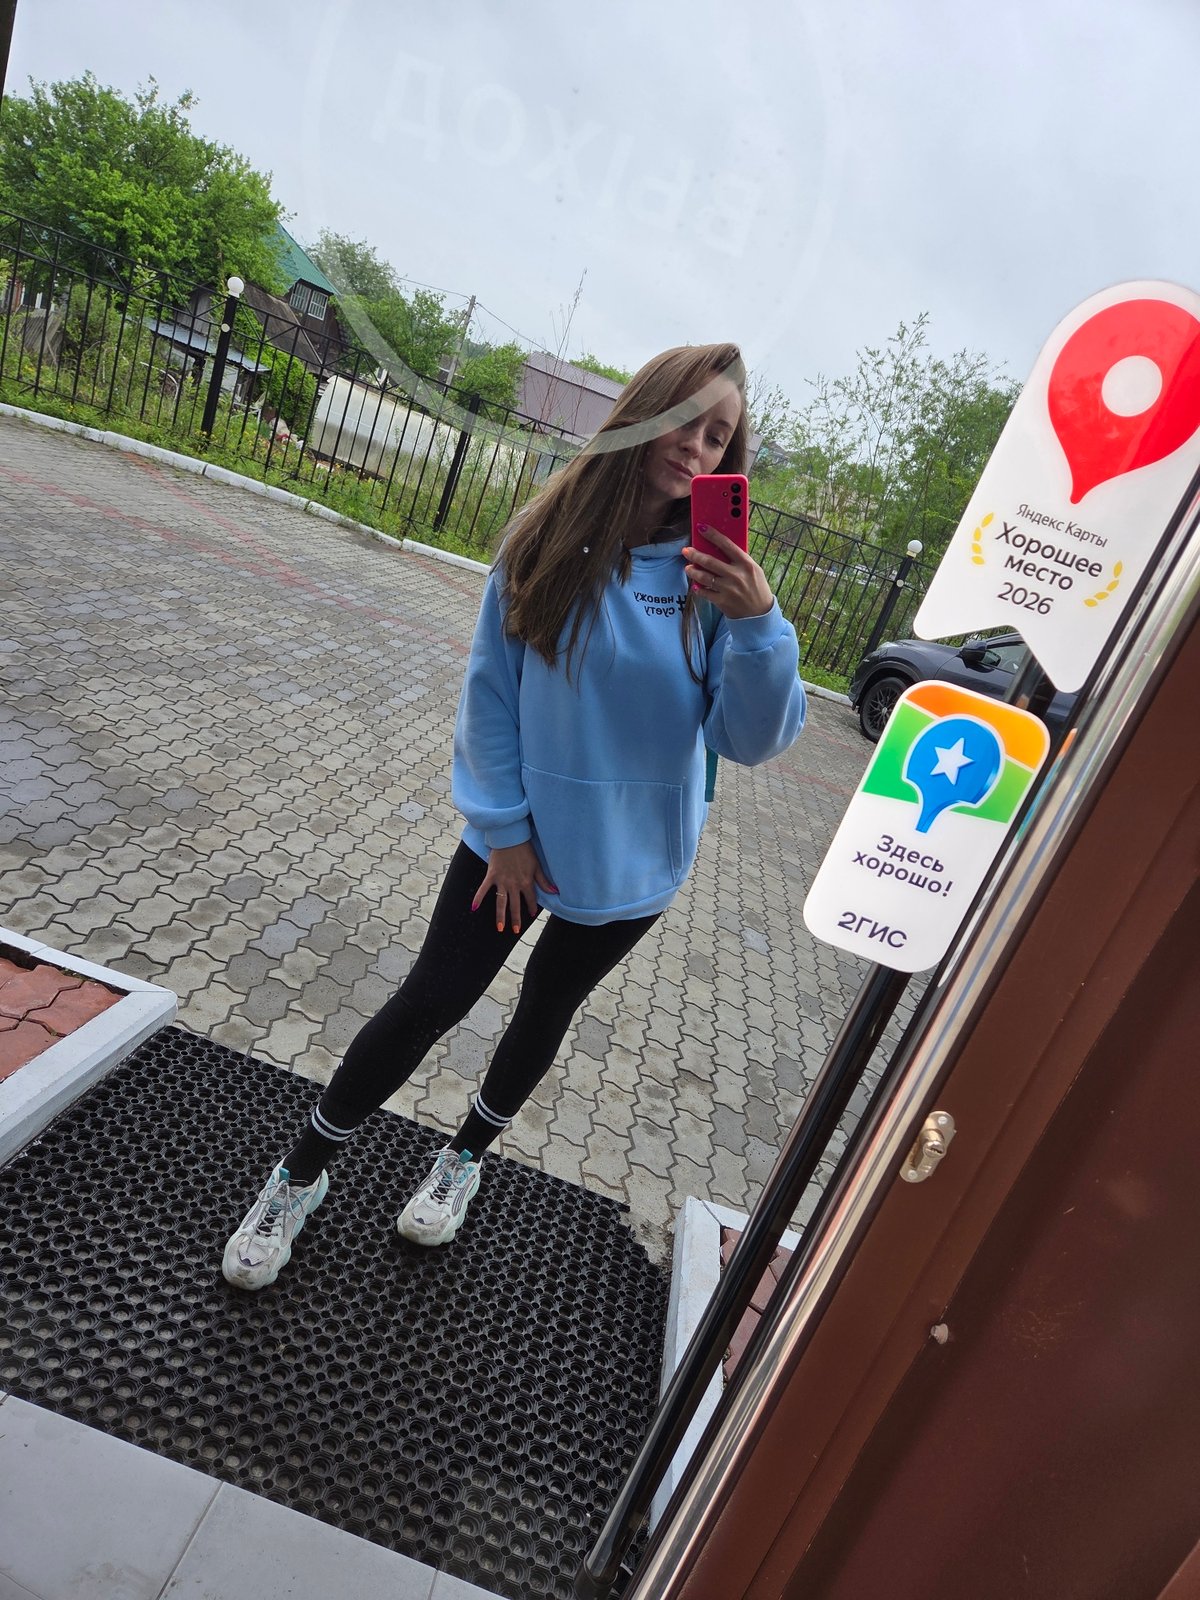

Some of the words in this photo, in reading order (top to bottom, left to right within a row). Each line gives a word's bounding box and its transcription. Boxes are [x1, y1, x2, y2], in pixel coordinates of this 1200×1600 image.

[1016, 503, 1065, 532] Яндекс
[1065, 520, 1109, 548] Карты
[995, 521, 1103, 578] Хорошее
[1004, 555, 1074, 590] место
[997, 581, 1054, 615] 2026
[876, 834, 945, 873] Здесь
[852, 850, 953, 897] хорошо!
[837, 911, 908, 949] 2ГИС
